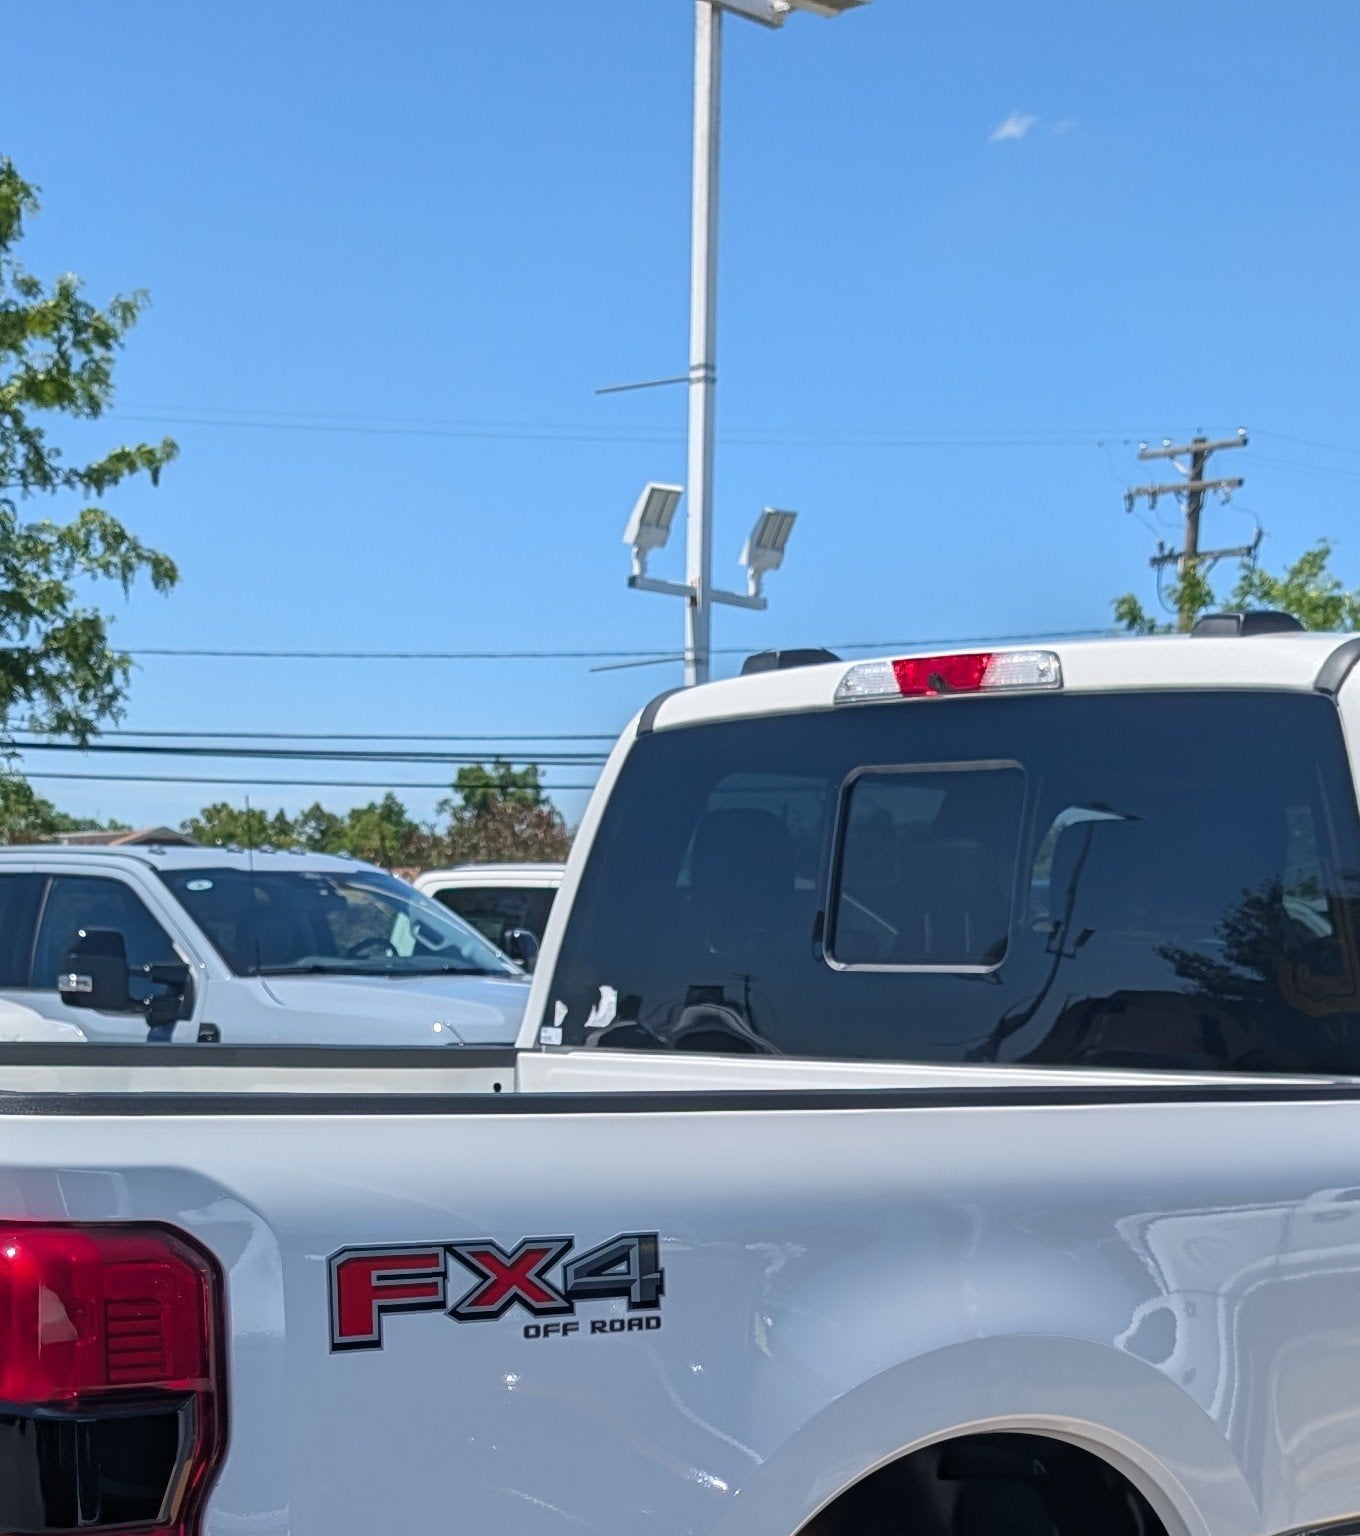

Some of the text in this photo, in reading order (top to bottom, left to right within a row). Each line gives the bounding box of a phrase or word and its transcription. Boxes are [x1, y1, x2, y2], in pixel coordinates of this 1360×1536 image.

[326, 1230, 665, 1354] FX4
[523, 1315, 662, 1339] OFF ROAD
